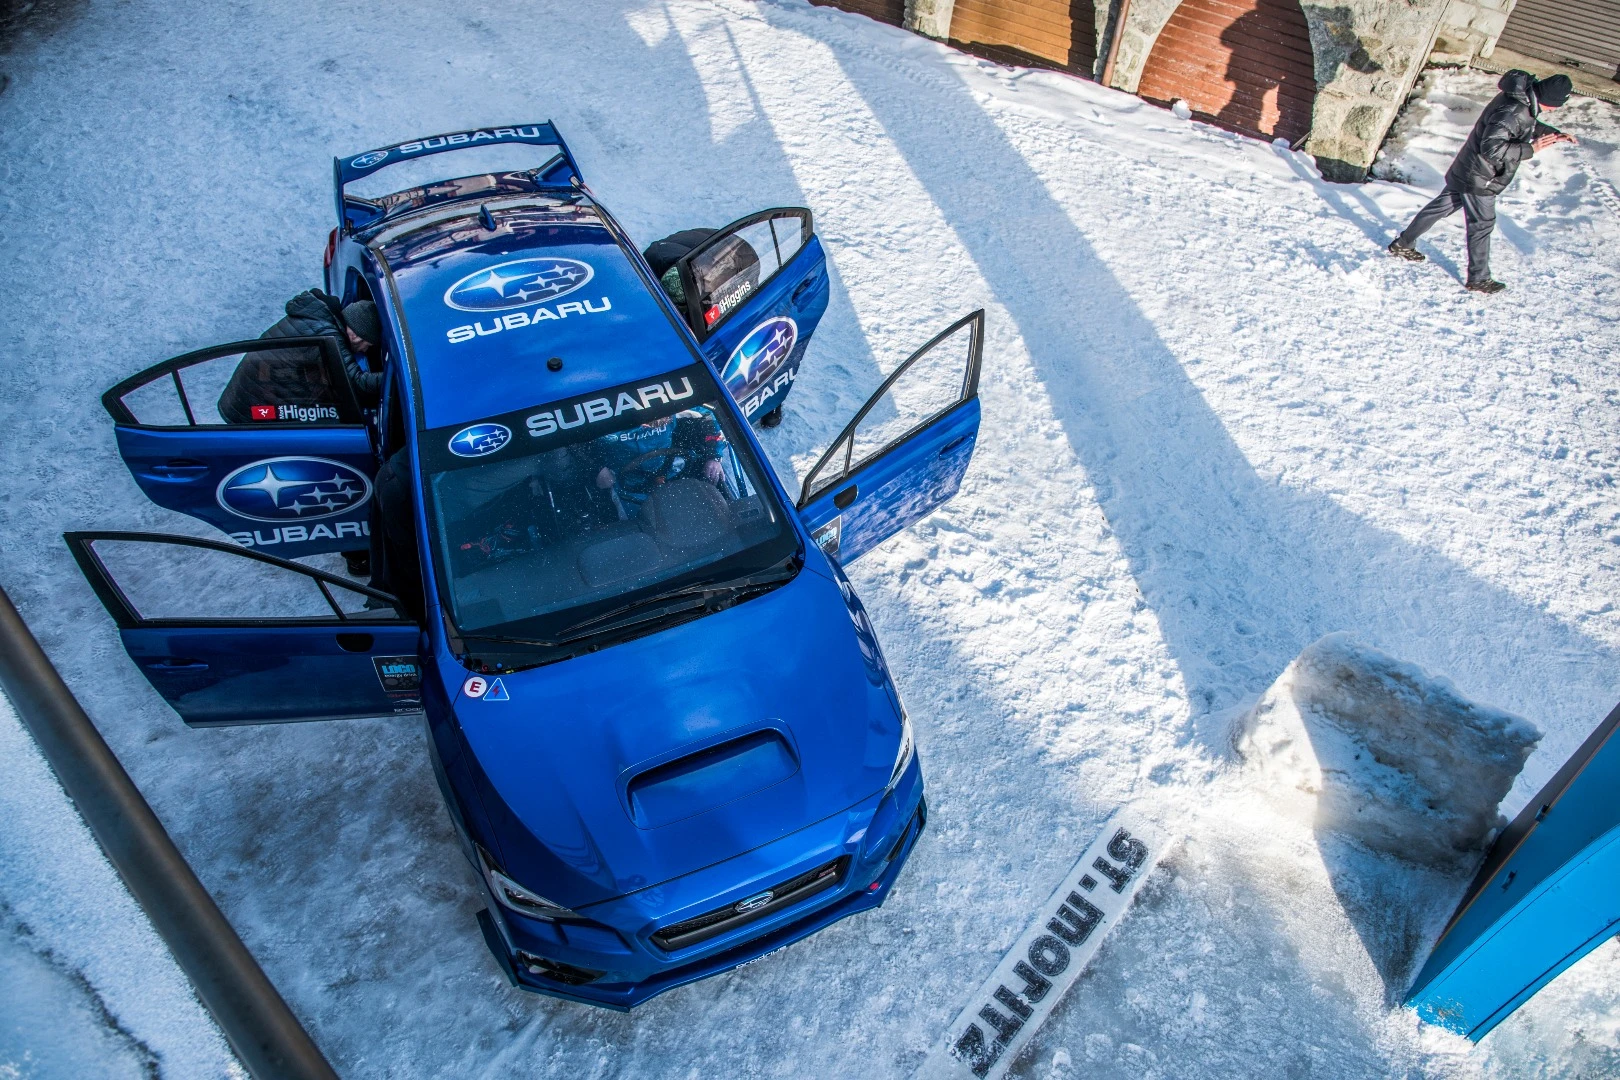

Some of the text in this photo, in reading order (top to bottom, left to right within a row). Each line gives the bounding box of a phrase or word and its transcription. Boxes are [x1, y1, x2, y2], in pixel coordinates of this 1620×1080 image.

[400, 126, 541, 154] SUBARU
[722, 280, 752, 311] Higgins
[446, 296, 612, 344] SUBARU
[284, 403, 337, 422] Higgins
[525, 376, 694, 438] SUBARU
[382, 664, 416, 674] LOCO
[469, 680, 482, 693] E
